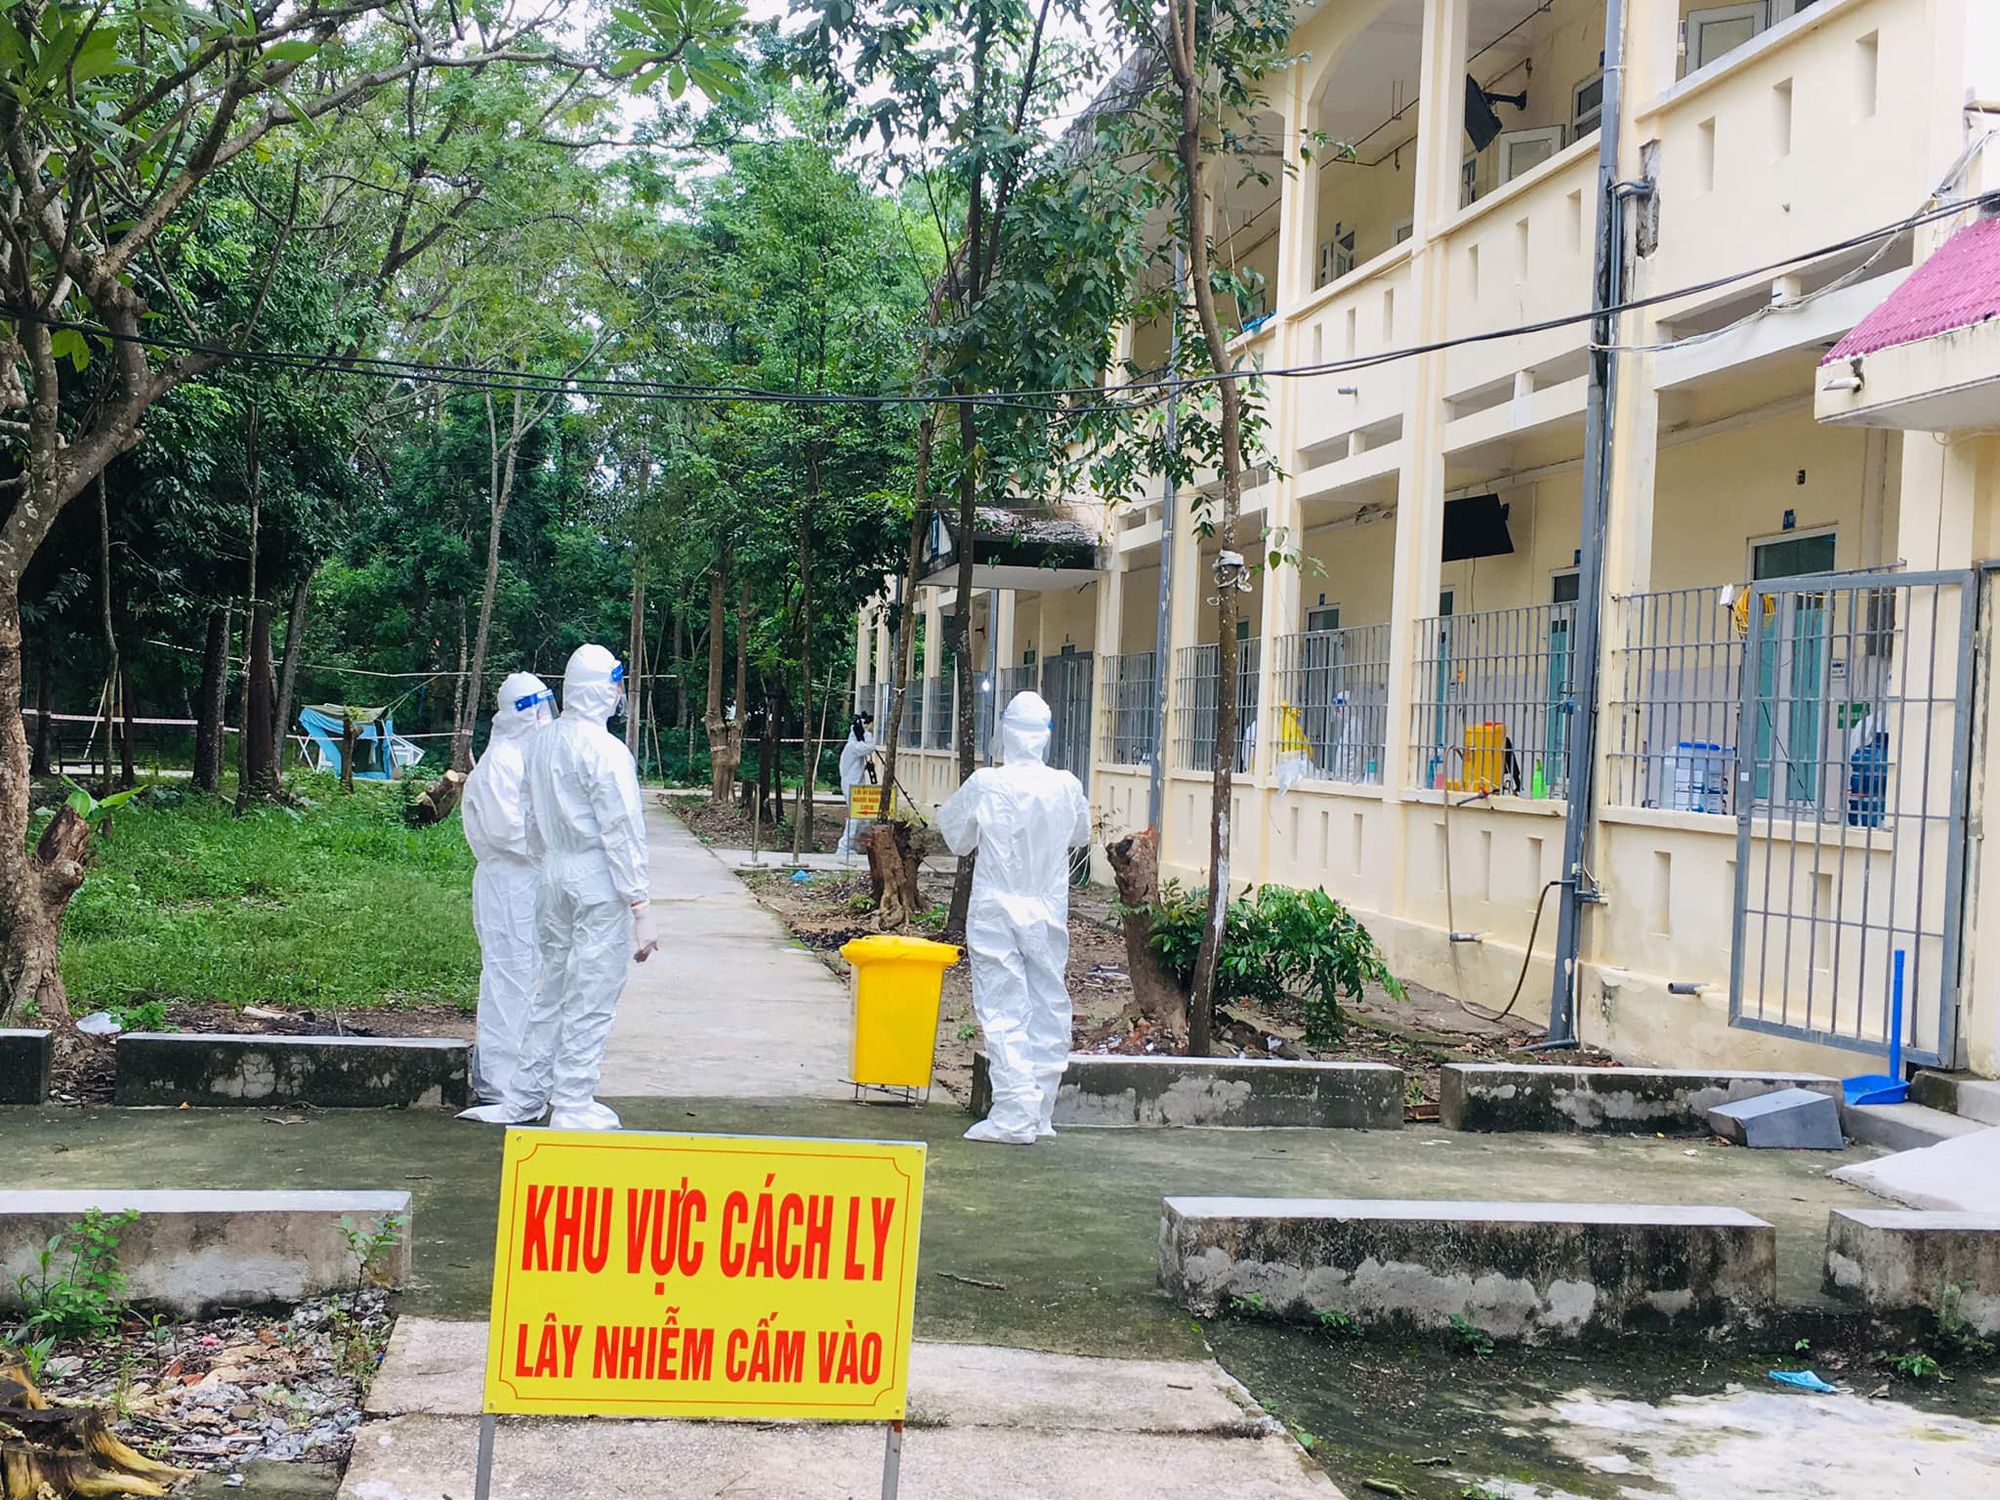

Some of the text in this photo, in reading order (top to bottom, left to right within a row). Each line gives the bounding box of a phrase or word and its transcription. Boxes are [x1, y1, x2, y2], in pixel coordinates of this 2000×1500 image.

[521, 1173, 896, 1296] KHU VỰC CÁCH LY
[515, 1306, 883, 1385] LÂY NHIỄM CẤM VÀO
